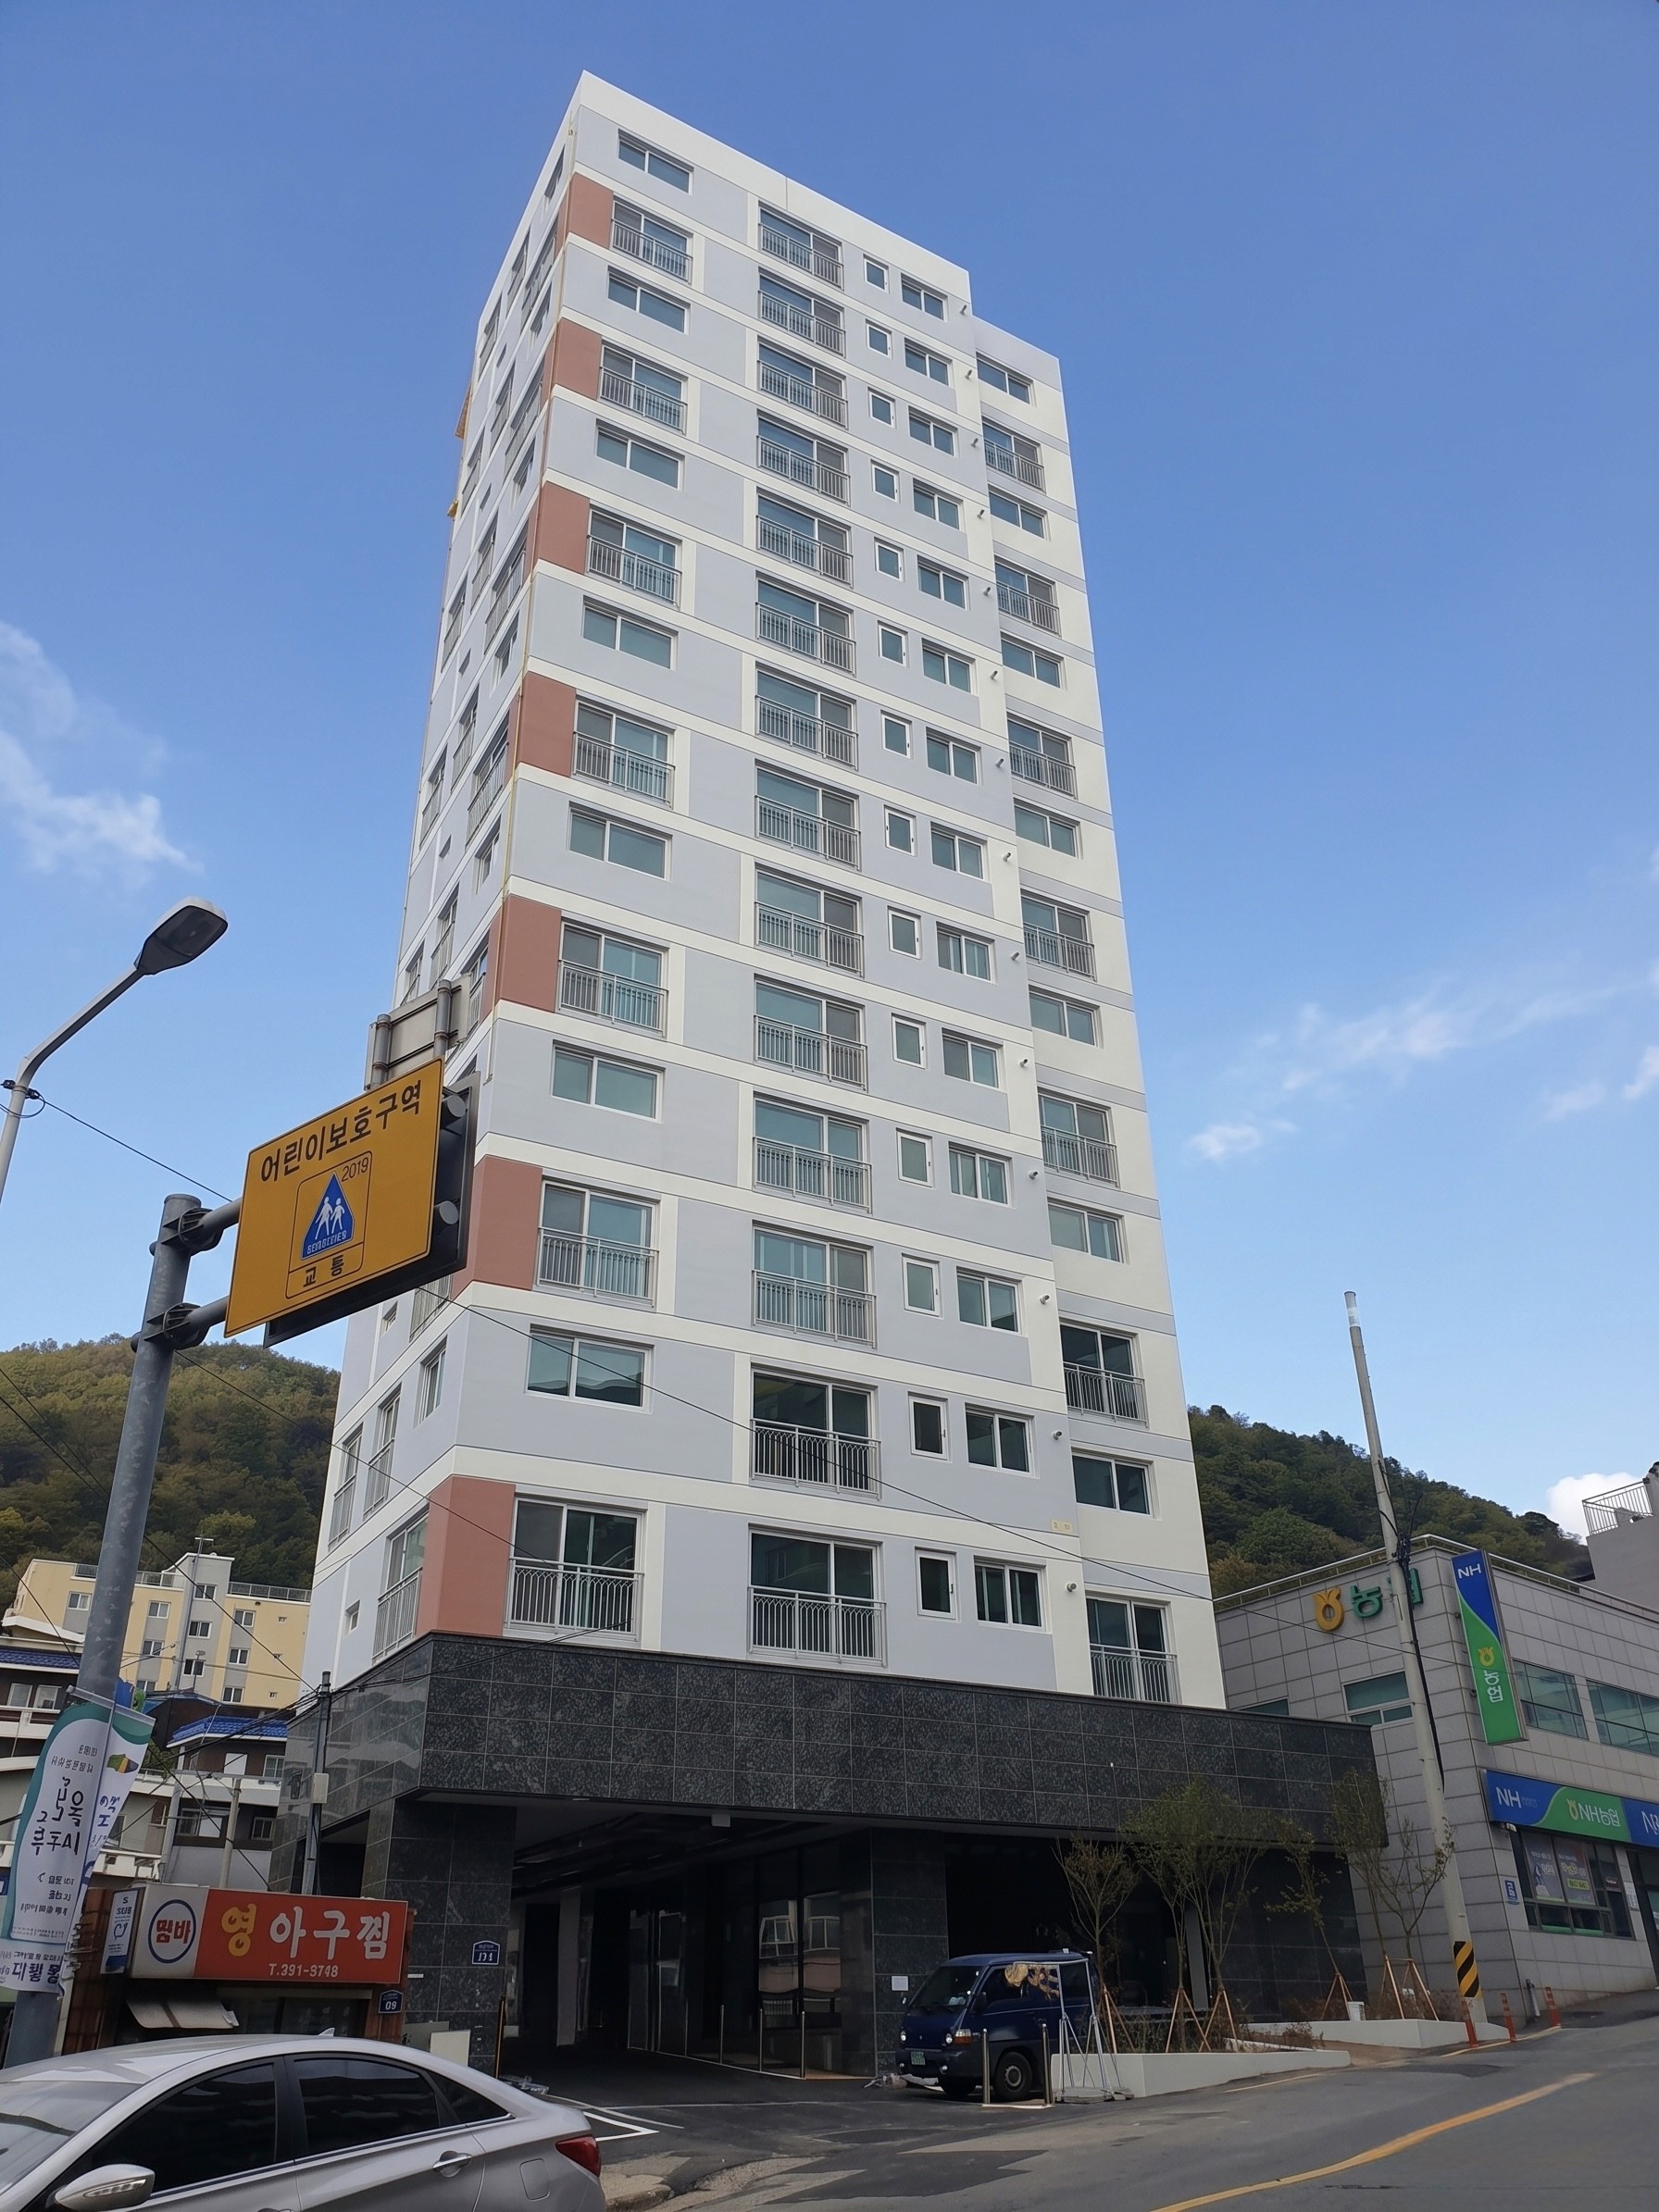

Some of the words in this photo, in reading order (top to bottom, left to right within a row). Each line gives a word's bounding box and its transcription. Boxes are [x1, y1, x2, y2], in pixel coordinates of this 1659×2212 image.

[260, 1079, 422, 1183] 어린이보호구역
[341, 1157, 370, 1183] 2019
[1457, 1563, 1482, 1579] NH
[1495, 1786, 1522, 1808] NH
[220, 1903, 257, 1957] 영
[268, 1905, 392, 1961] 아구찜
